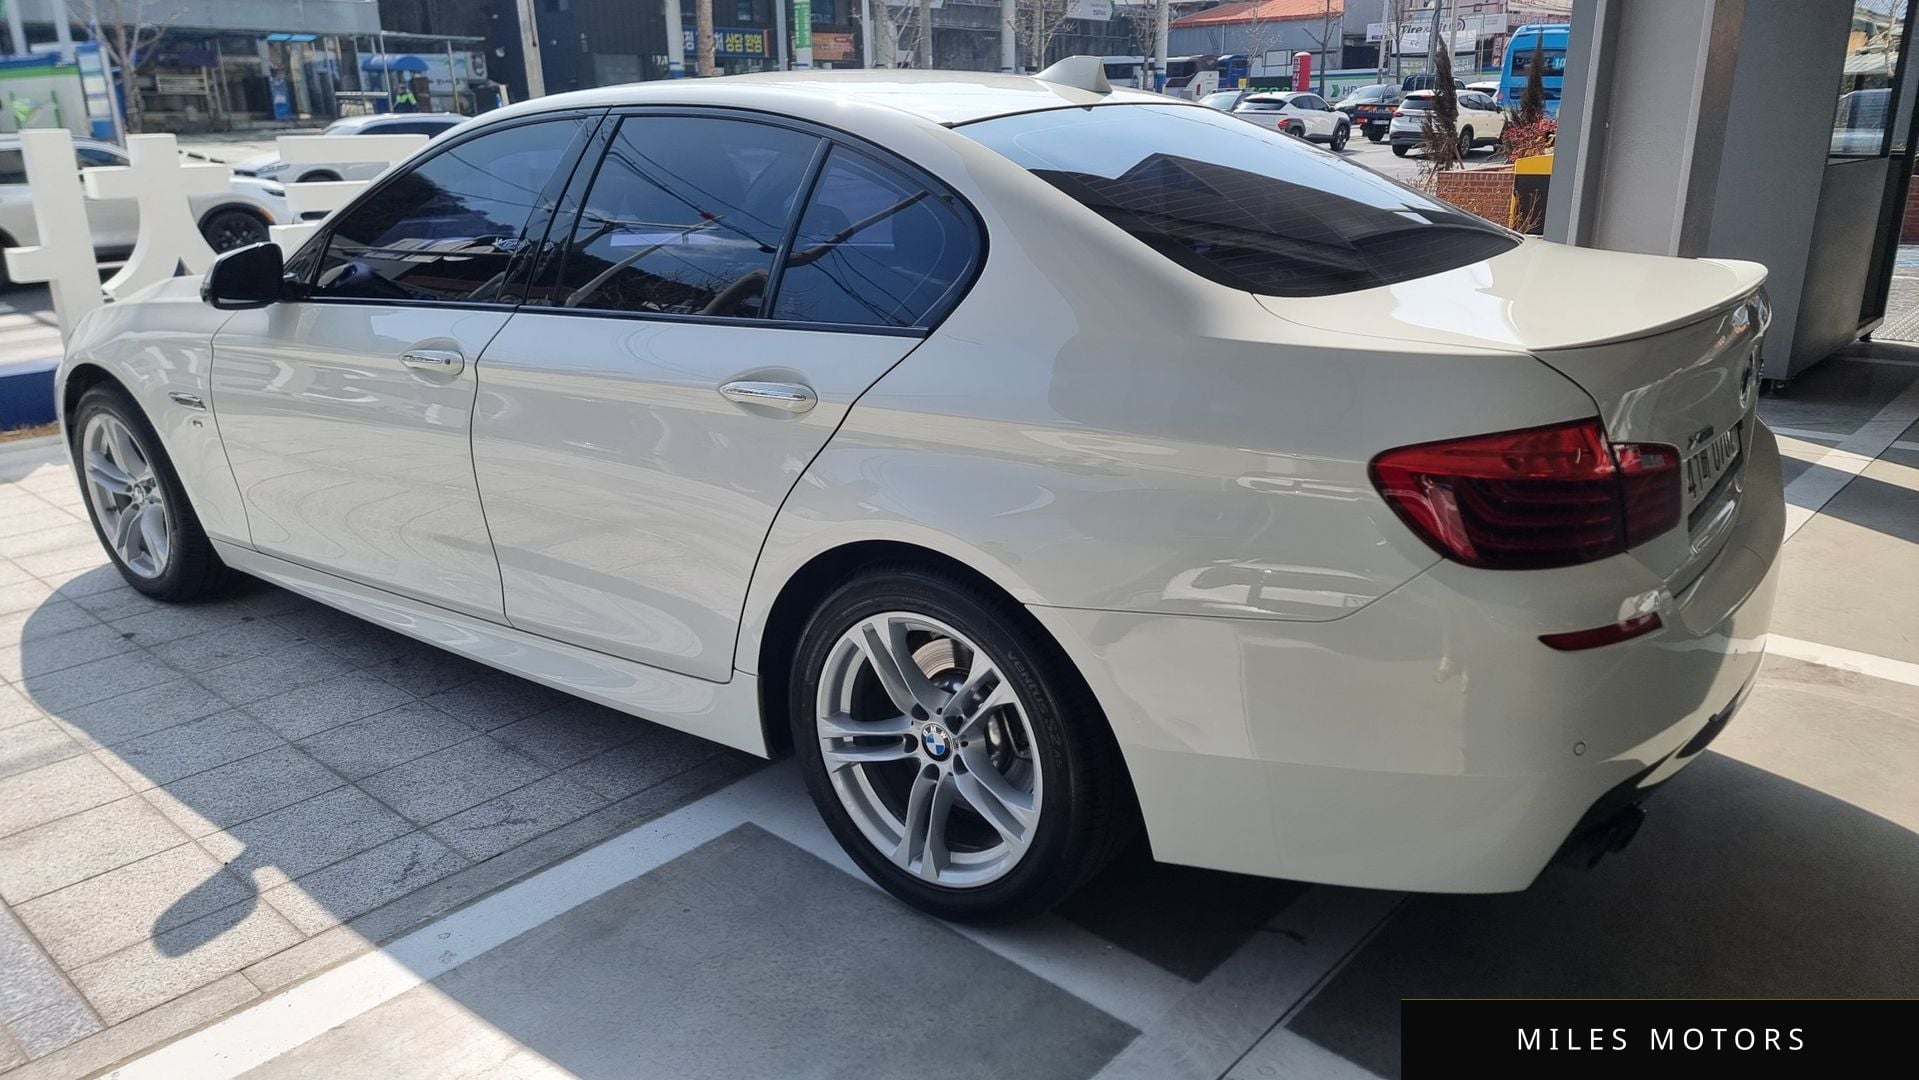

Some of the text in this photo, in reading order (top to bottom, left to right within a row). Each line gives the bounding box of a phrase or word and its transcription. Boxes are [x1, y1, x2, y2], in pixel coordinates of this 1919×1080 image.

[725, 32, 743, 52] 상담
[745, 33, 763, 54] 환영
[922, 725, 949, 738] BMW
